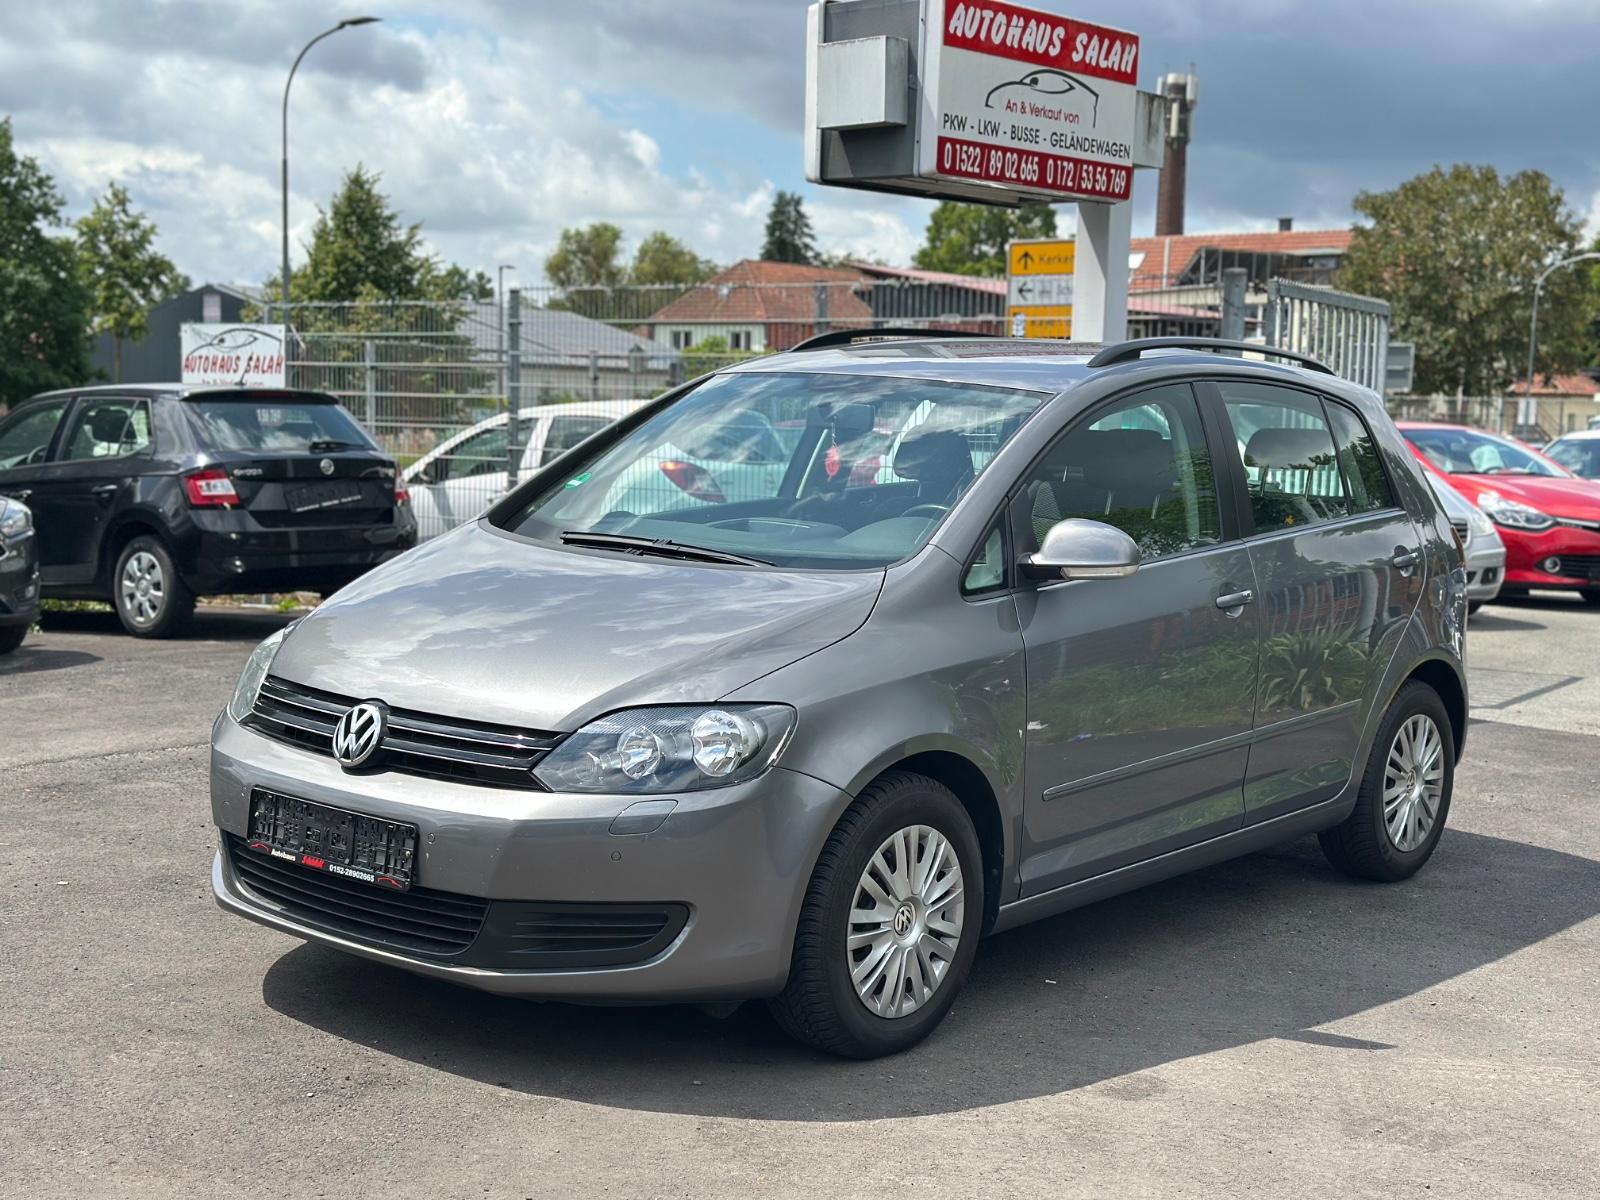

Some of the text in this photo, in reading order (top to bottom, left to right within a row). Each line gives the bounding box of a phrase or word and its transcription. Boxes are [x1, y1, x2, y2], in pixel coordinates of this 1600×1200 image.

[949, 3, 1137, 74] AUTOHAUS SALAH
[1005, 98, 1080, 125] An & Verkauf von
[943, 113, 968, 132] PKW
[978, 118, 1001, 137] LKW
[1010, 124, 1040, 144] BUSSE
[1050, 130, 1131, 160] GELÄNDEWAGEN
[944, 143, 951, 170] 0
[956, 145, 981, 174] 1522
[989, 150, 1003, 176] 89
[1005, 152, 1018, 179] 02
[1020, 154, 1039, 183] 665
[1046, 158, 1053, 184] 0
[1057, 160, 1073, 187] 172
[1081, 164, 1093, 190] 53
[1095, 167, 1107, 192] 56
[1109, 168, 1127, 195] 769
[183, 354, 283, 375] AUTOHAUS SALAH
